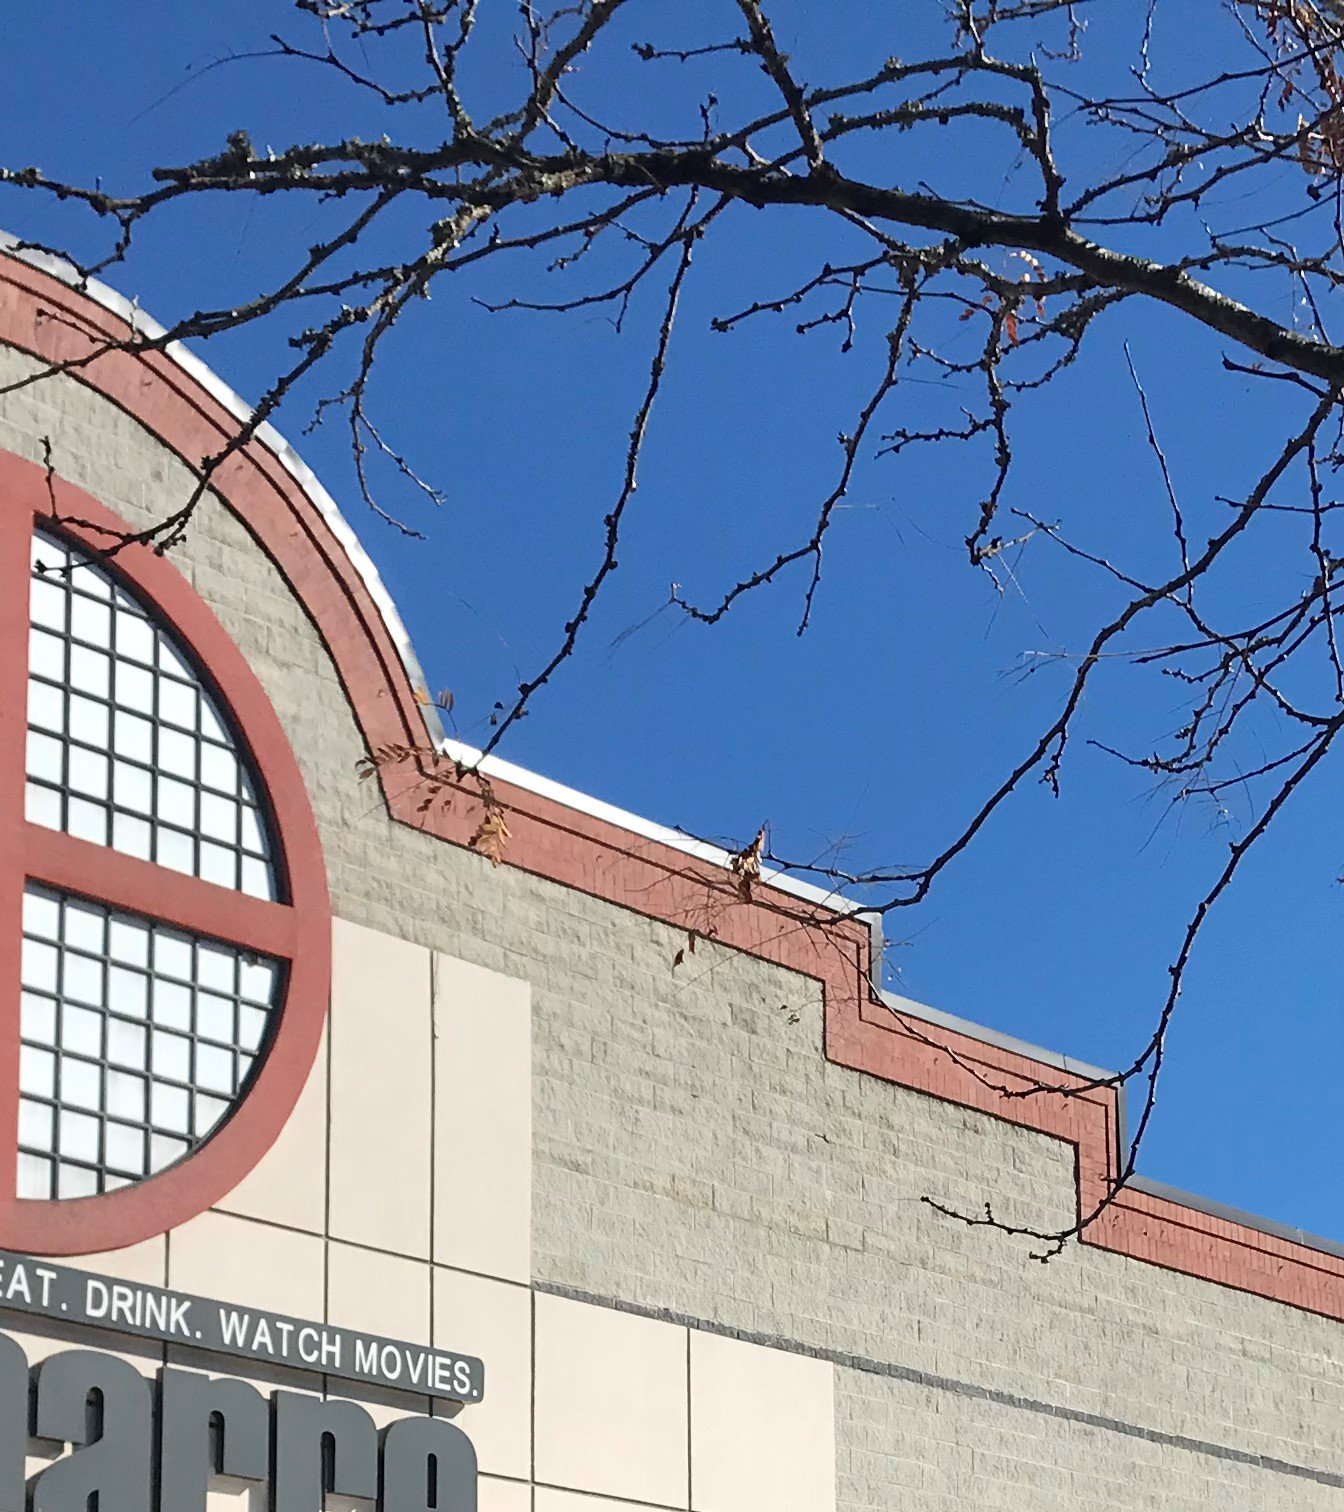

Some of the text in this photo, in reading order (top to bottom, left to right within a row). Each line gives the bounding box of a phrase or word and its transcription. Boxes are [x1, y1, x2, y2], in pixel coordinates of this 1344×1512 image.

[84, 1278, 202, 1340] DRINK.
[219, 1307, 342, 1369] WATCH
[355, 1341, 479, 1397] MOVIES.
